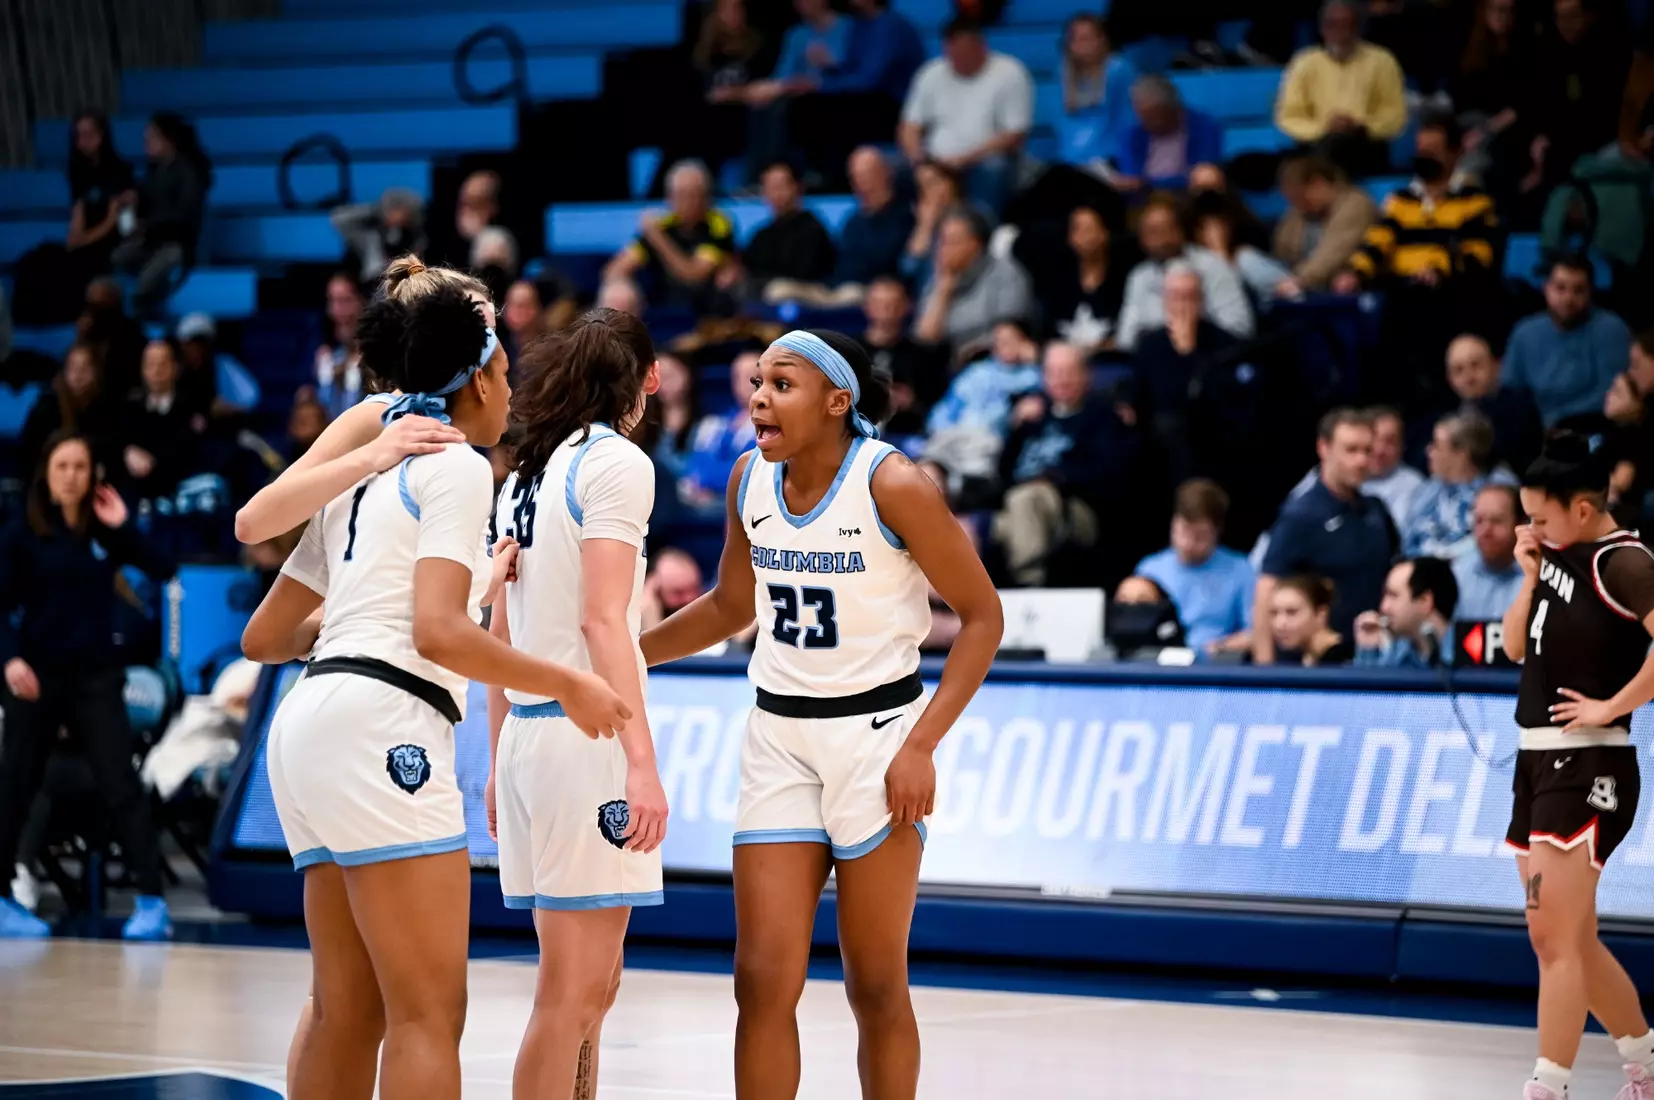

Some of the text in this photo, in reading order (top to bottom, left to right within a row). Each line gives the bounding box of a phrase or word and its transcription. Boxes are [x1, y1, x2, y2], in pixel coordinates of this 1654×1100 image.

[343, 483, 369, 562] 1
[838, 527, 853, 538] Ivy
[751, 544, 866, 574] COLUMBIA
[766, 582, 840, 650] 23
[1530, 598, 1549, 656] 4
[934, 716, 1342, 849] GOURMET
[1339, 727, 1518, 858] DEL
